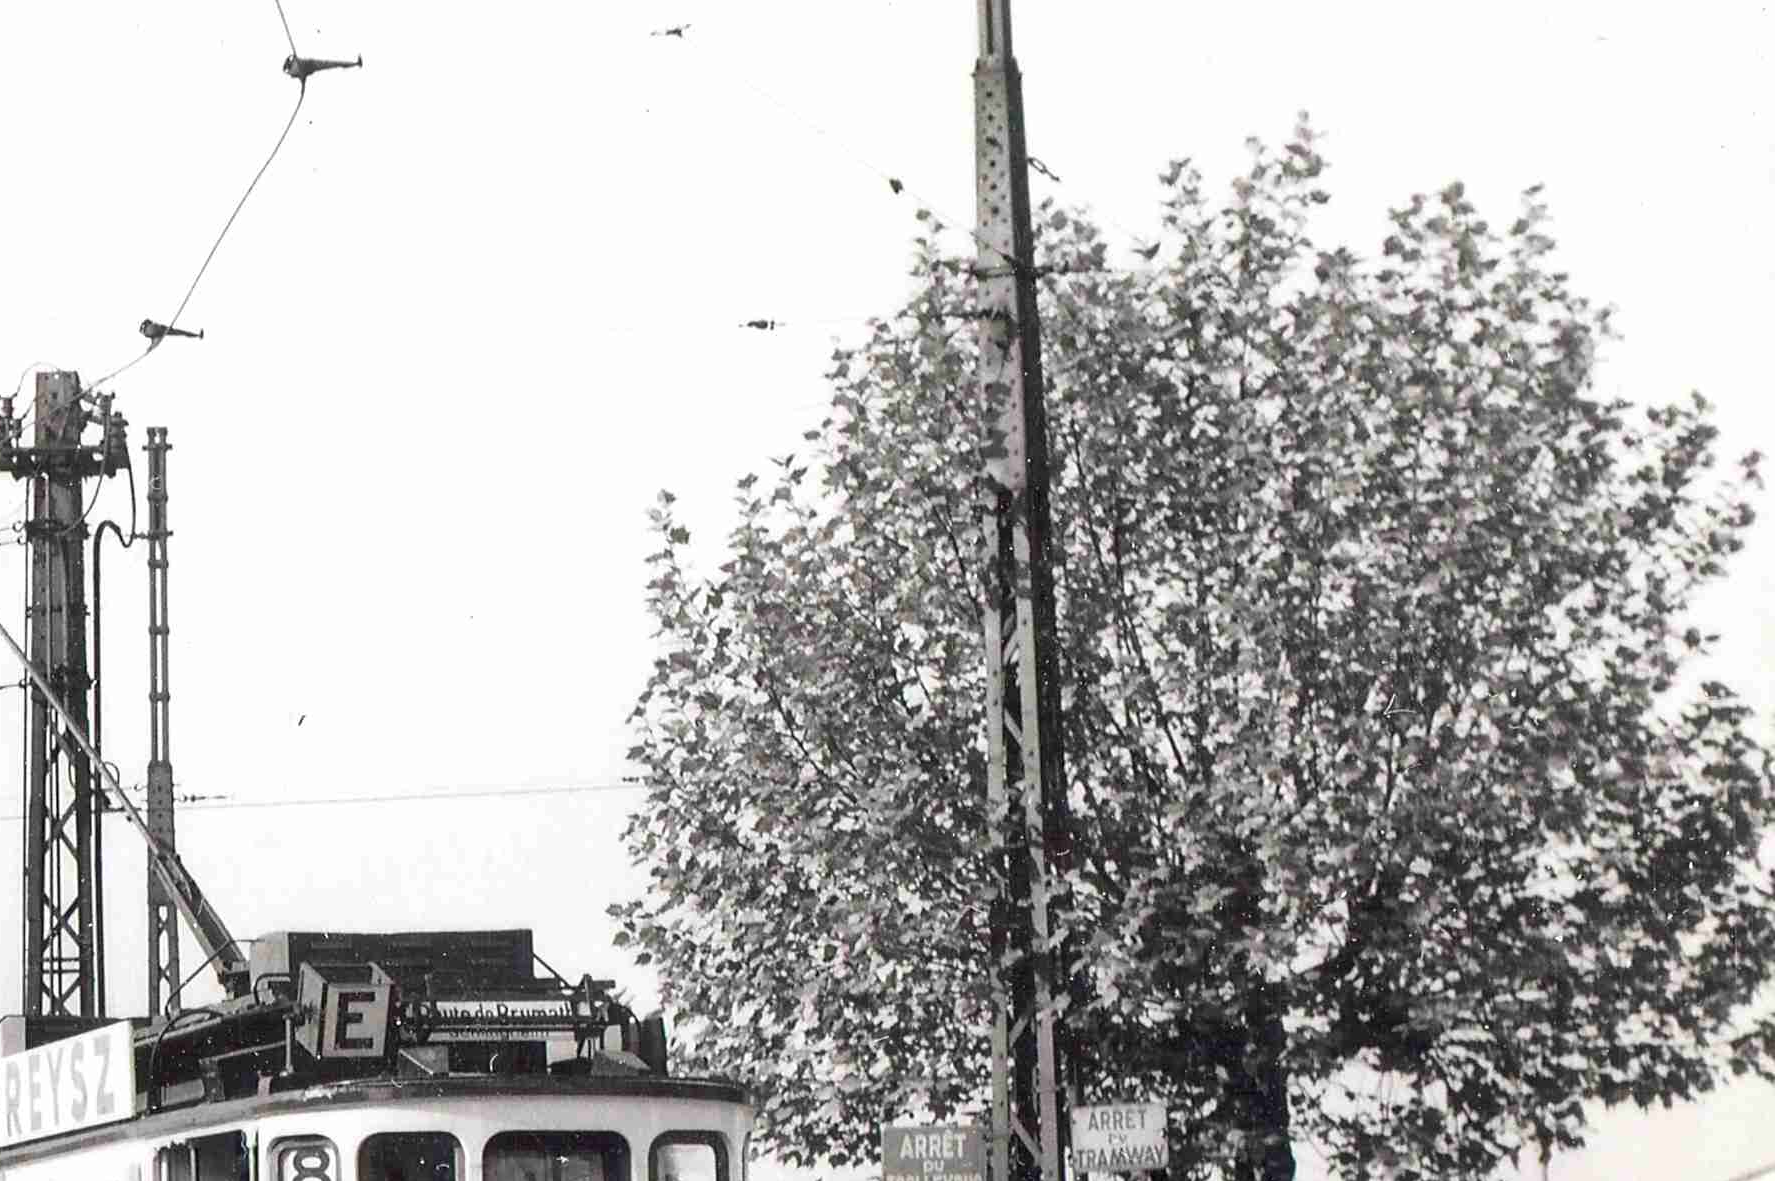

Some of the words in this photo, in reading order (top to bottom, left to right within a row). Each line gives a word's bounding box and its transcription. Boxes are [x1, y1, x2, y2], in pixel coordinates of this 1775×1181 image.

[335, 991, 374, 1049] E
[923, 1160, 945, 1174] DU
[1077, 1145, 1163, 1170] TRAMWAY
